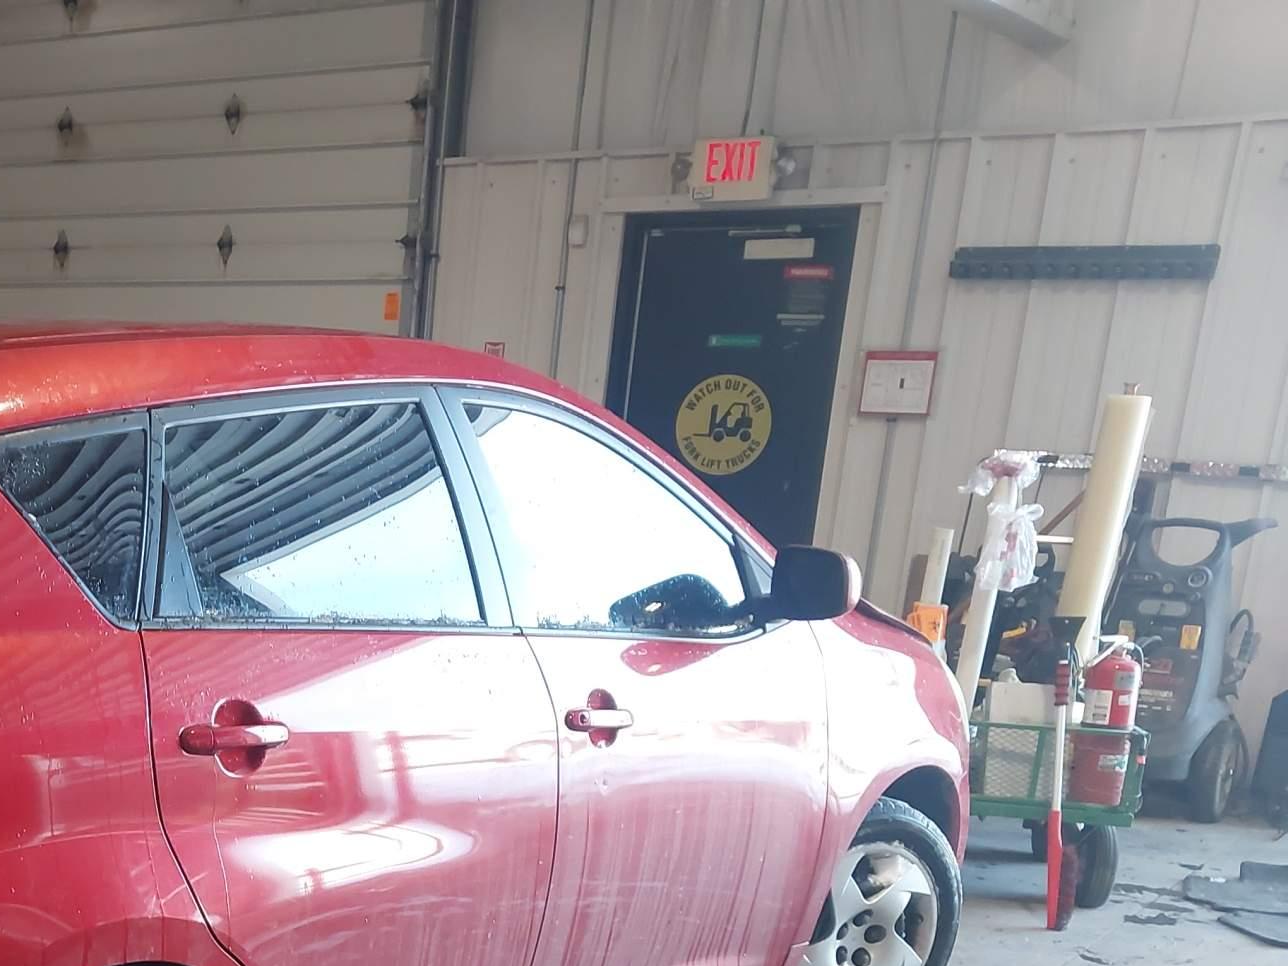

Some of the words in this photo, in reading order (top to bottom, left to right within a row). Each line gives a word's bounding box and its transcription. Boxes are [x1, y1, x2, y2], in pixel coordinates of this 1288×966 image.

[705, 141, 761, 183] EXIT
[686, 380, 721, 411] WATCH
[724, 378, 748, 393] OUT
[746, 389, 765, 413] FOR
[682, 436, 701, 460] FORK
[700, 456, 722, 470] LIFT
[724, 439, 761, 469] TRUCKS
